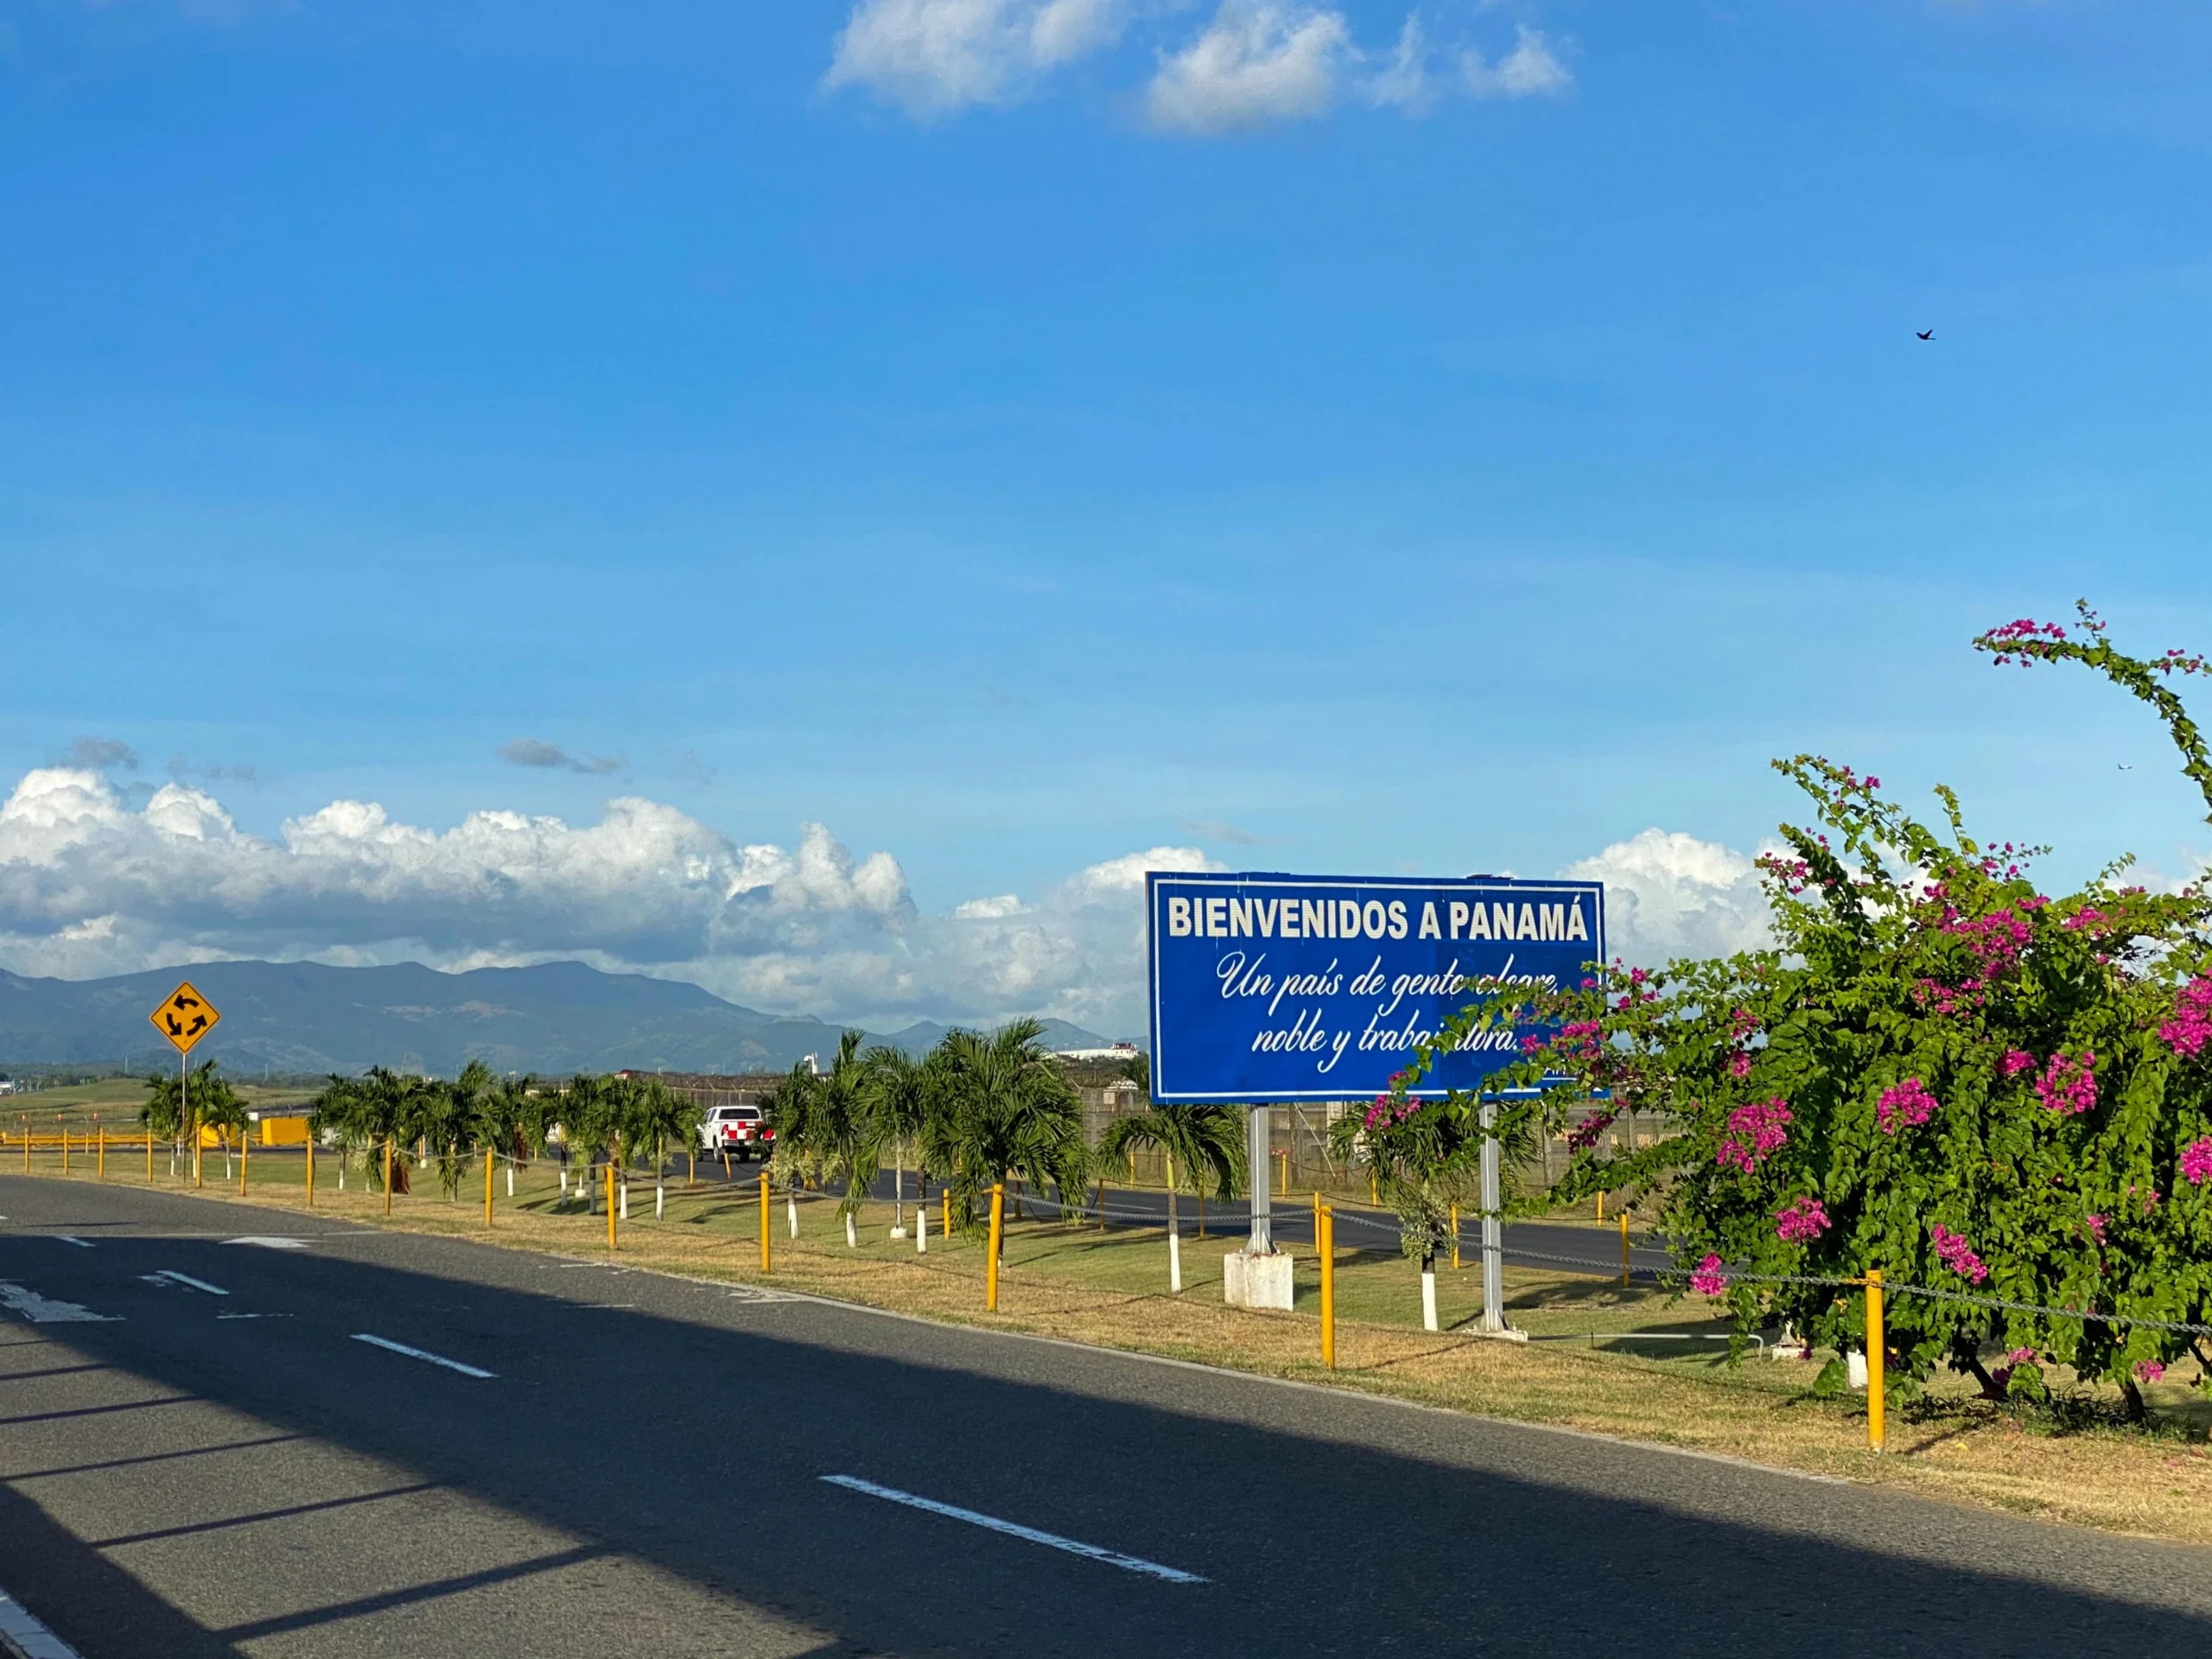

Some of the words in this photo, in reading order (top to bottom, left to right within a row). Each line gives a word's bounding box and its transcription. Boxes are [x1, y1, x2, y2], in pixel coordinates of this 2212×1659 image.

[1168, 896, 1408, 940] BIENVENIDOS
[1418, 901, 1442, 940] A
[1449, 894, 1589, 942] PANAMÁ
[1216, 950, 1275, 999] Un
[1268, 957, 1344, 1017] país
[1350, 954, 1387, 995] de
[1377, 957, 1466, 1017] gente
[1251, 1007, 1328, 1052] noble
[1317, 1030, 1351, 1073] y
